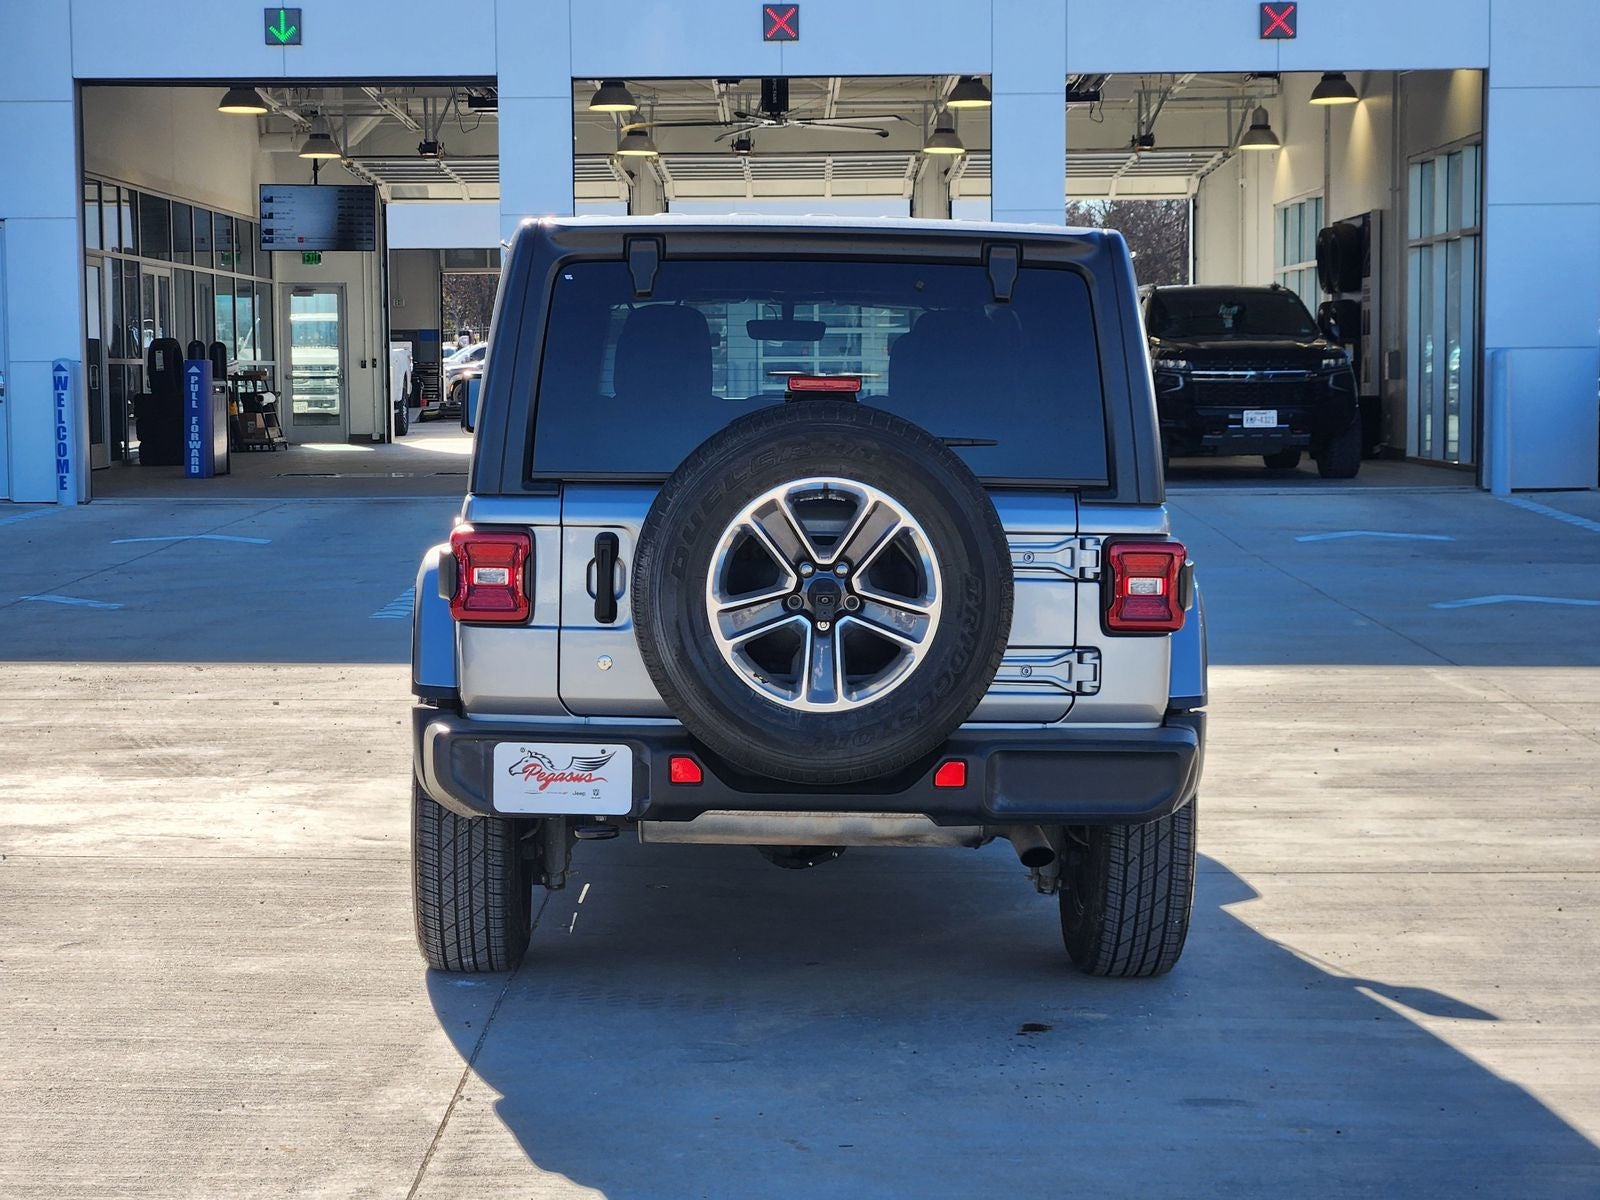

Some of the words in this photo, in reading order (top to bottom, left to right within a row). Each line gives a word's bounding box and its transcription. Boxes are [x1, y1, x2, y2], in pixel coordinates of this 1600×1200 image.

[190, 375, 199, 408] PULL
[53, 375, 70, 490] WELCOME
[188, 416, 201, 473] FORWARD
[522, 763, 608, 791] Pegasus
